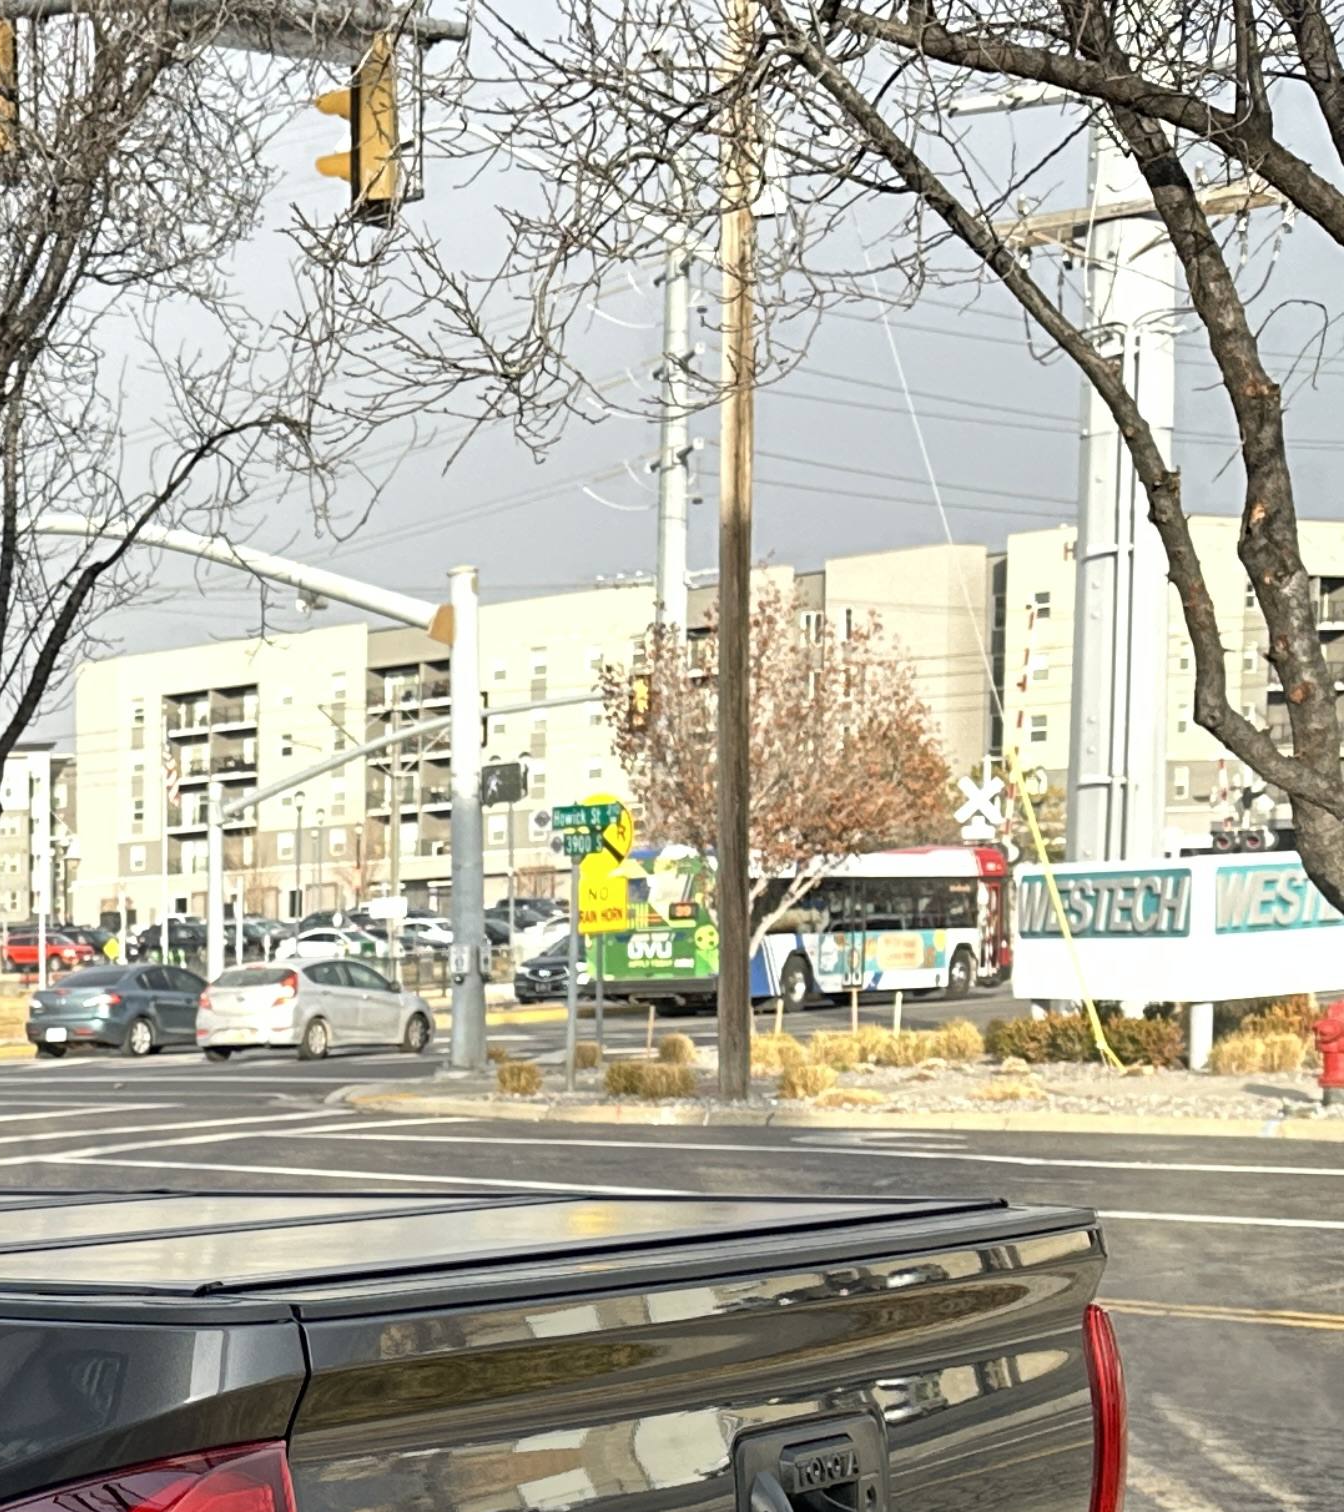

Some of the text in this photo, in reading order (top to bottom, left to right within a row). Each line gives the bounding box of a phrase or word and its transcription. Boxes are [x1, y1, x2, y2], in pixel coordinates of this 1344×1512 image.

[566, 834, 592, 853] 3900
[588, 887, 608, 900] NO
[1018, 875, 1191, 932] WESTECH
[601, 908, 623, 921] HORN
[627, 940, 673, 960] UVU
[795, 1449, 860, 1488] TOYOTA
